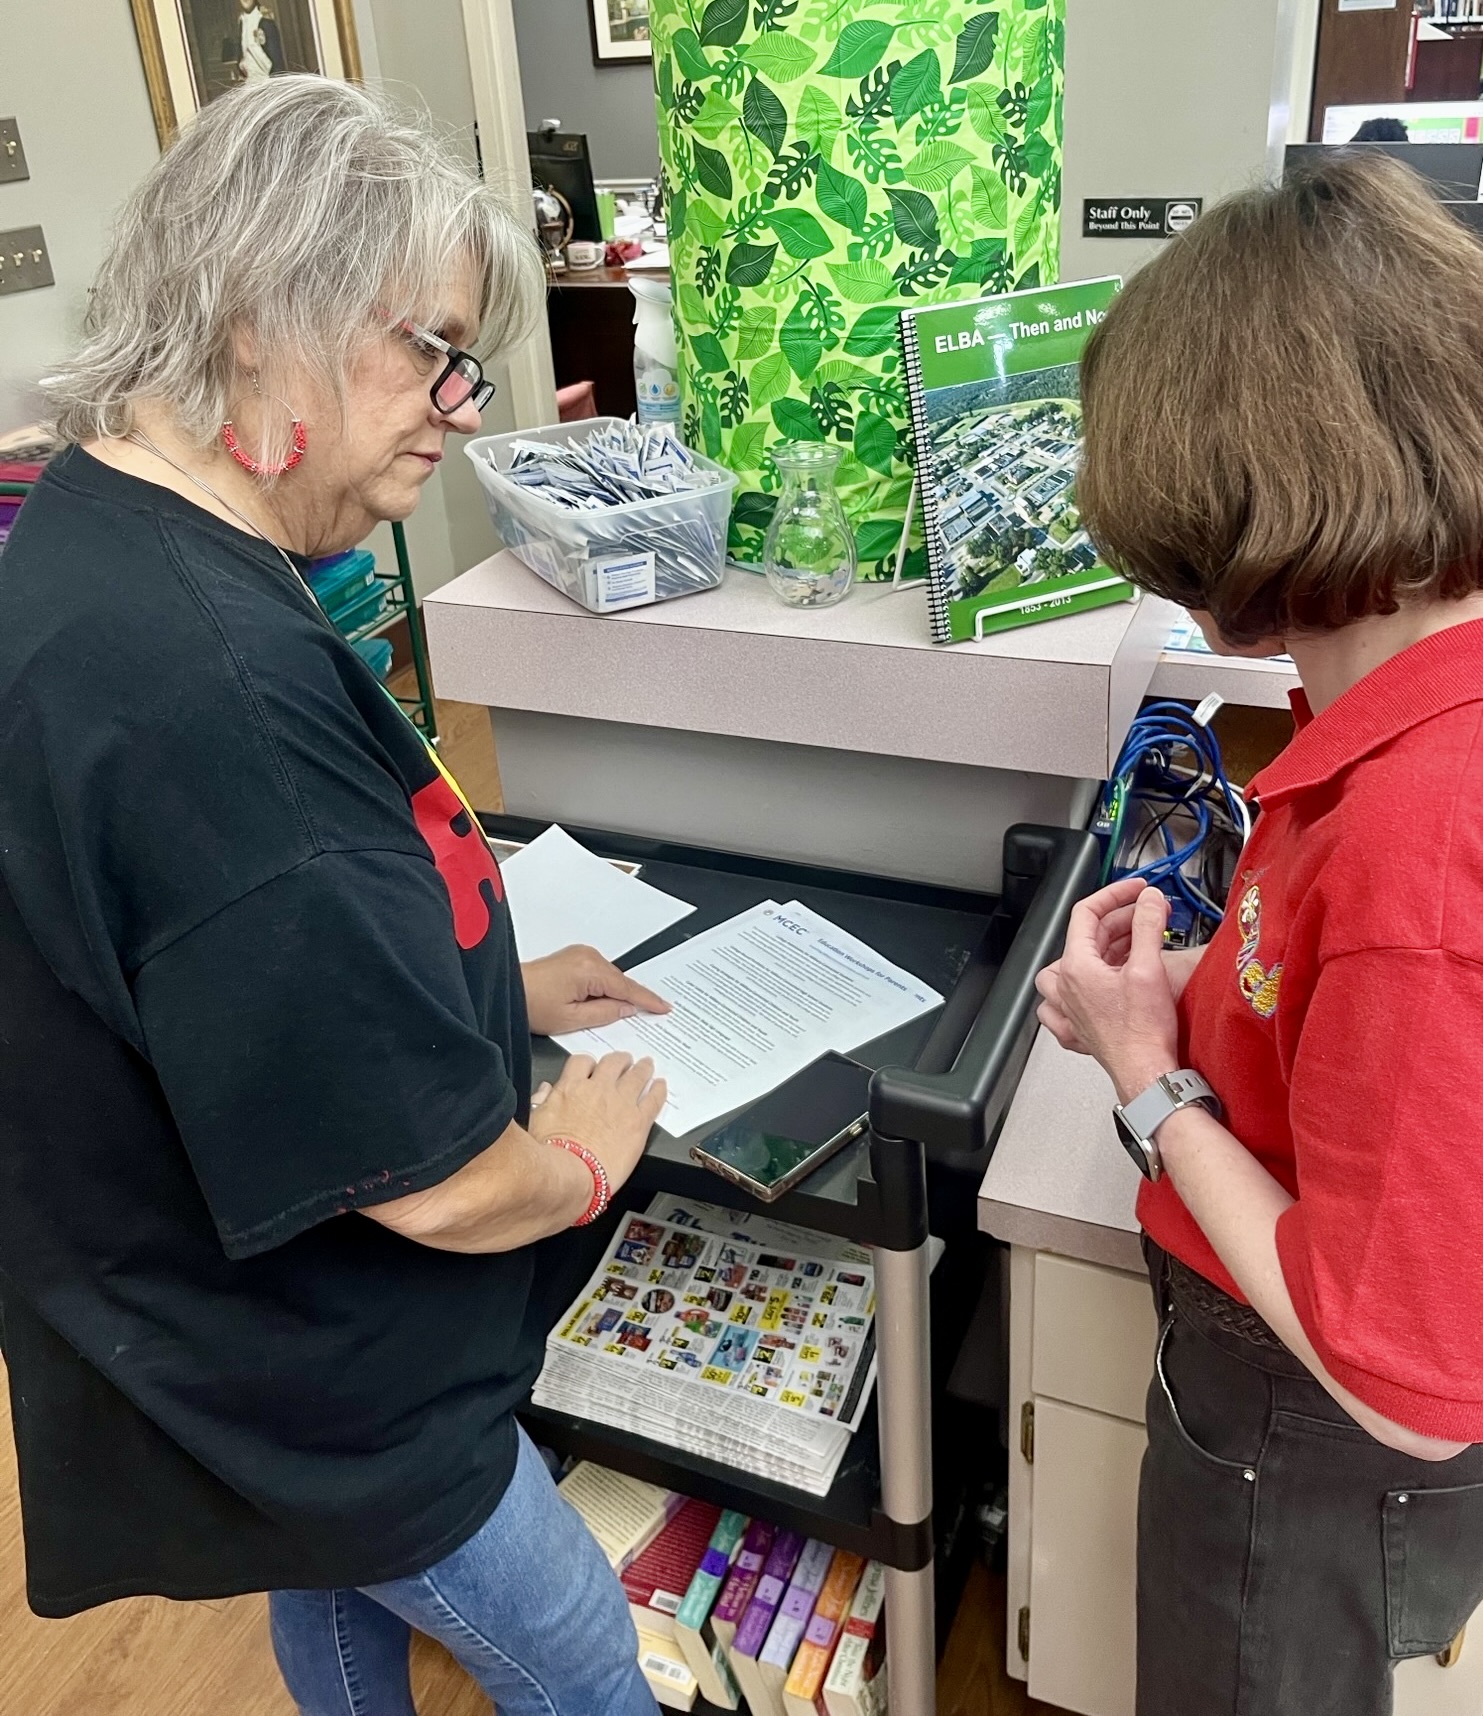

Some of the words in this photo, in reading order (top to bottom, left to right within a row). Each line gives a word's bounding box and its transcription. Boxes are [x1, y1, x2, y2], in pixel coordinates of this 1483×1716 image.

[1089, 206, 1118, 219] Staff
[1120, 206, 1151, 222] Only
[1089, 221, 1118, 232] Beyond
[1120, 221, 1136, 230] This
[1138, 221, 1160, 230] Point
[934, 328, 984, 354] ELBA
[1009, 320, 1050, 340] Then
[1053, 311, 1083, 331] and
[1085, 308, 1107, 326] No
[1020, 603, 1041, 615] 1853
[1050, 596, 1072, 609] 2013
[773, 914, 807, 936] MCEC
[817, 938, 845, 957] Education
[844, 953, 875, 974] Workshops
[884, 976, 908, 992] Parents
